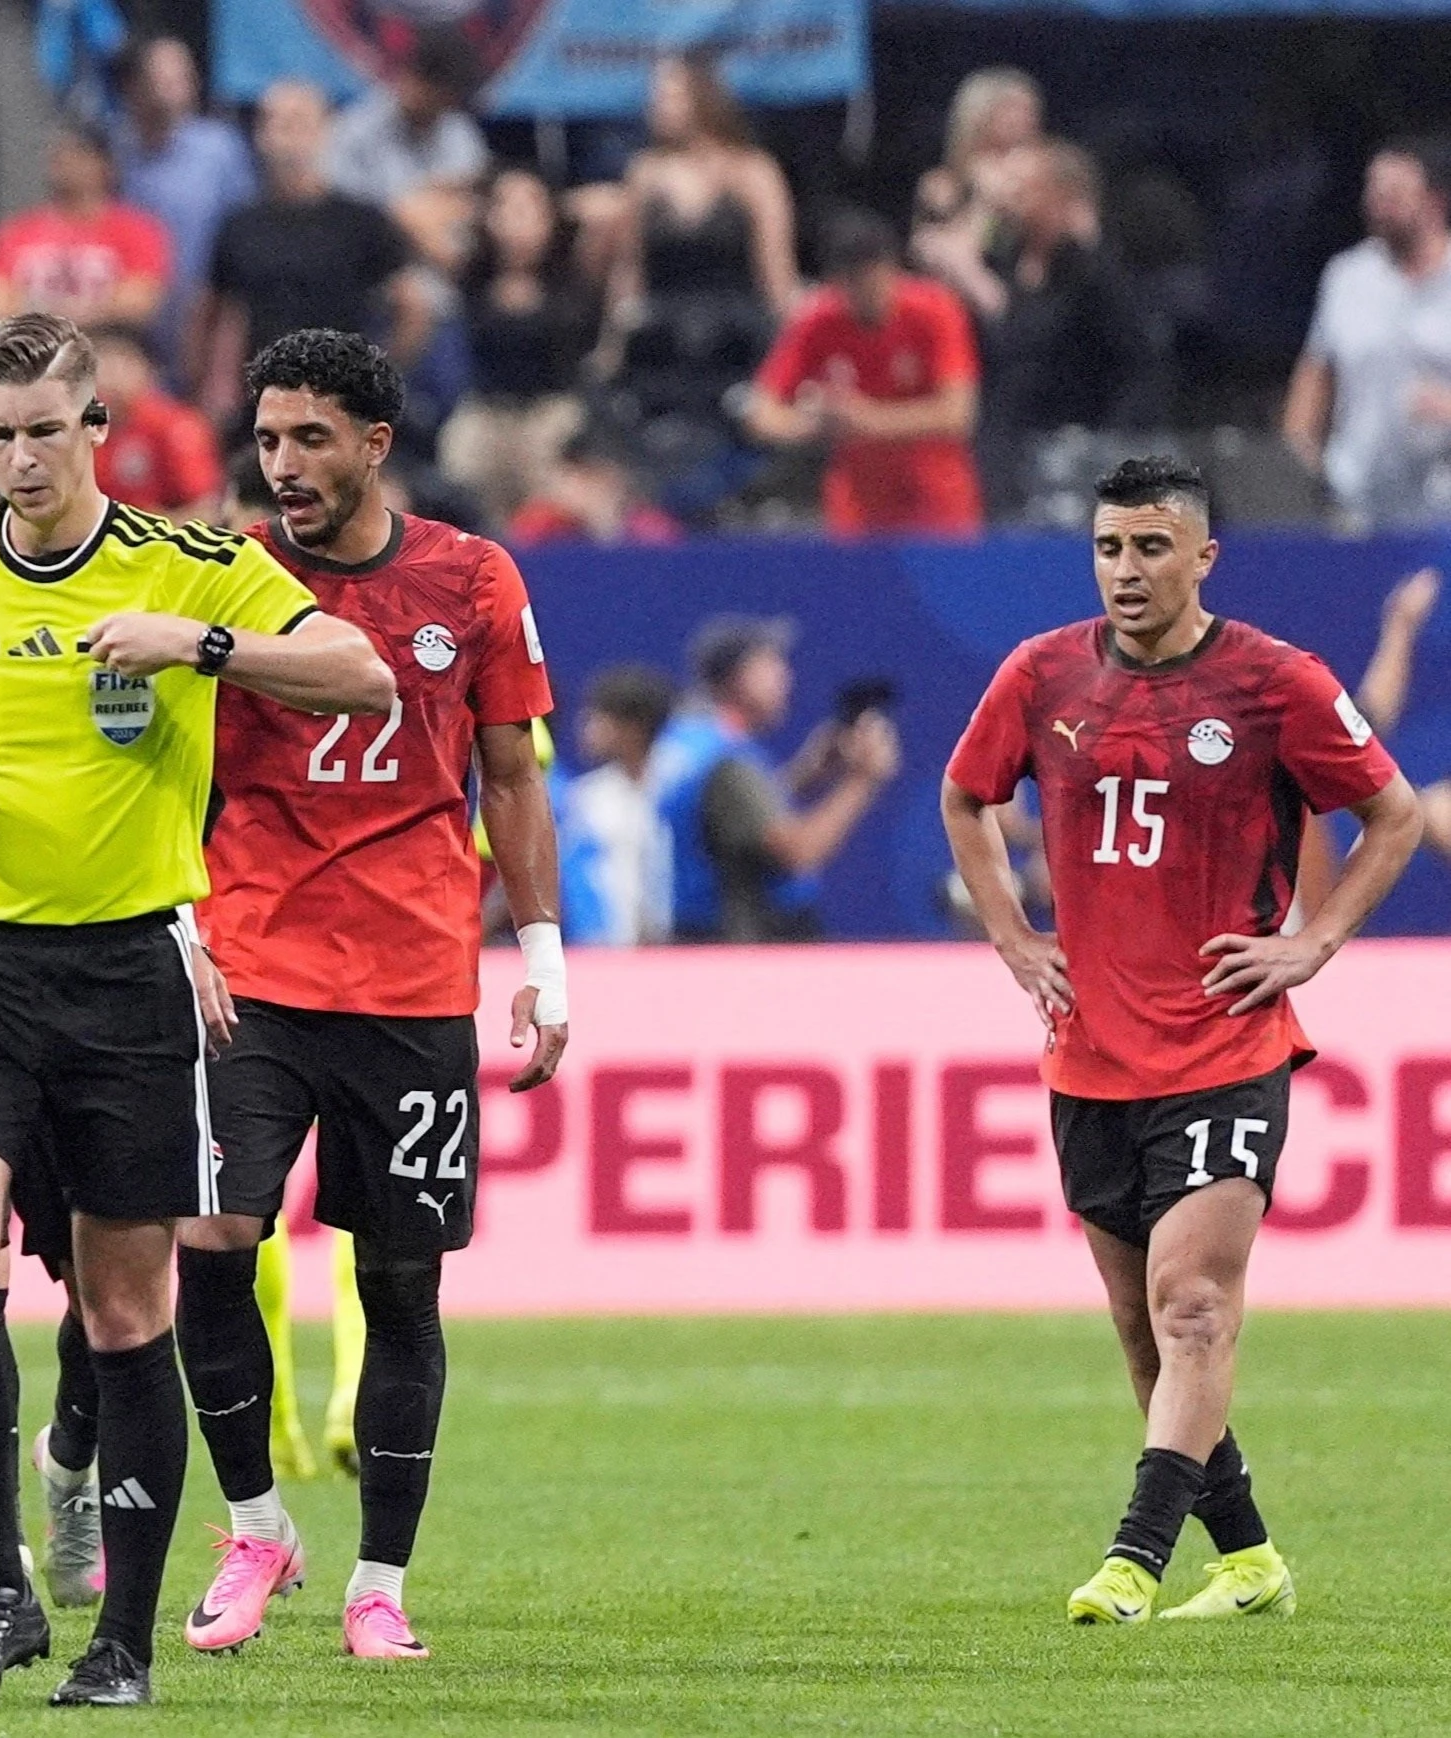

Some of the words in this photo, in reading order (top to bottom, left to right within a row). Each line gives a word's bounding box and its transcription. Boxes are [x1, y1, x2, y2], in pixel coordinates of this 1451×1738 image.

[95, 673, 149, 690] FIFA
[95, 702, 149, 714] REFEREE
[307, 693, 403, 783] 22
[1093, 776, 1171, 868] 15
[389, 1089, 468, 1180] 22
[1185, 1118, 1269, 1186] 15
